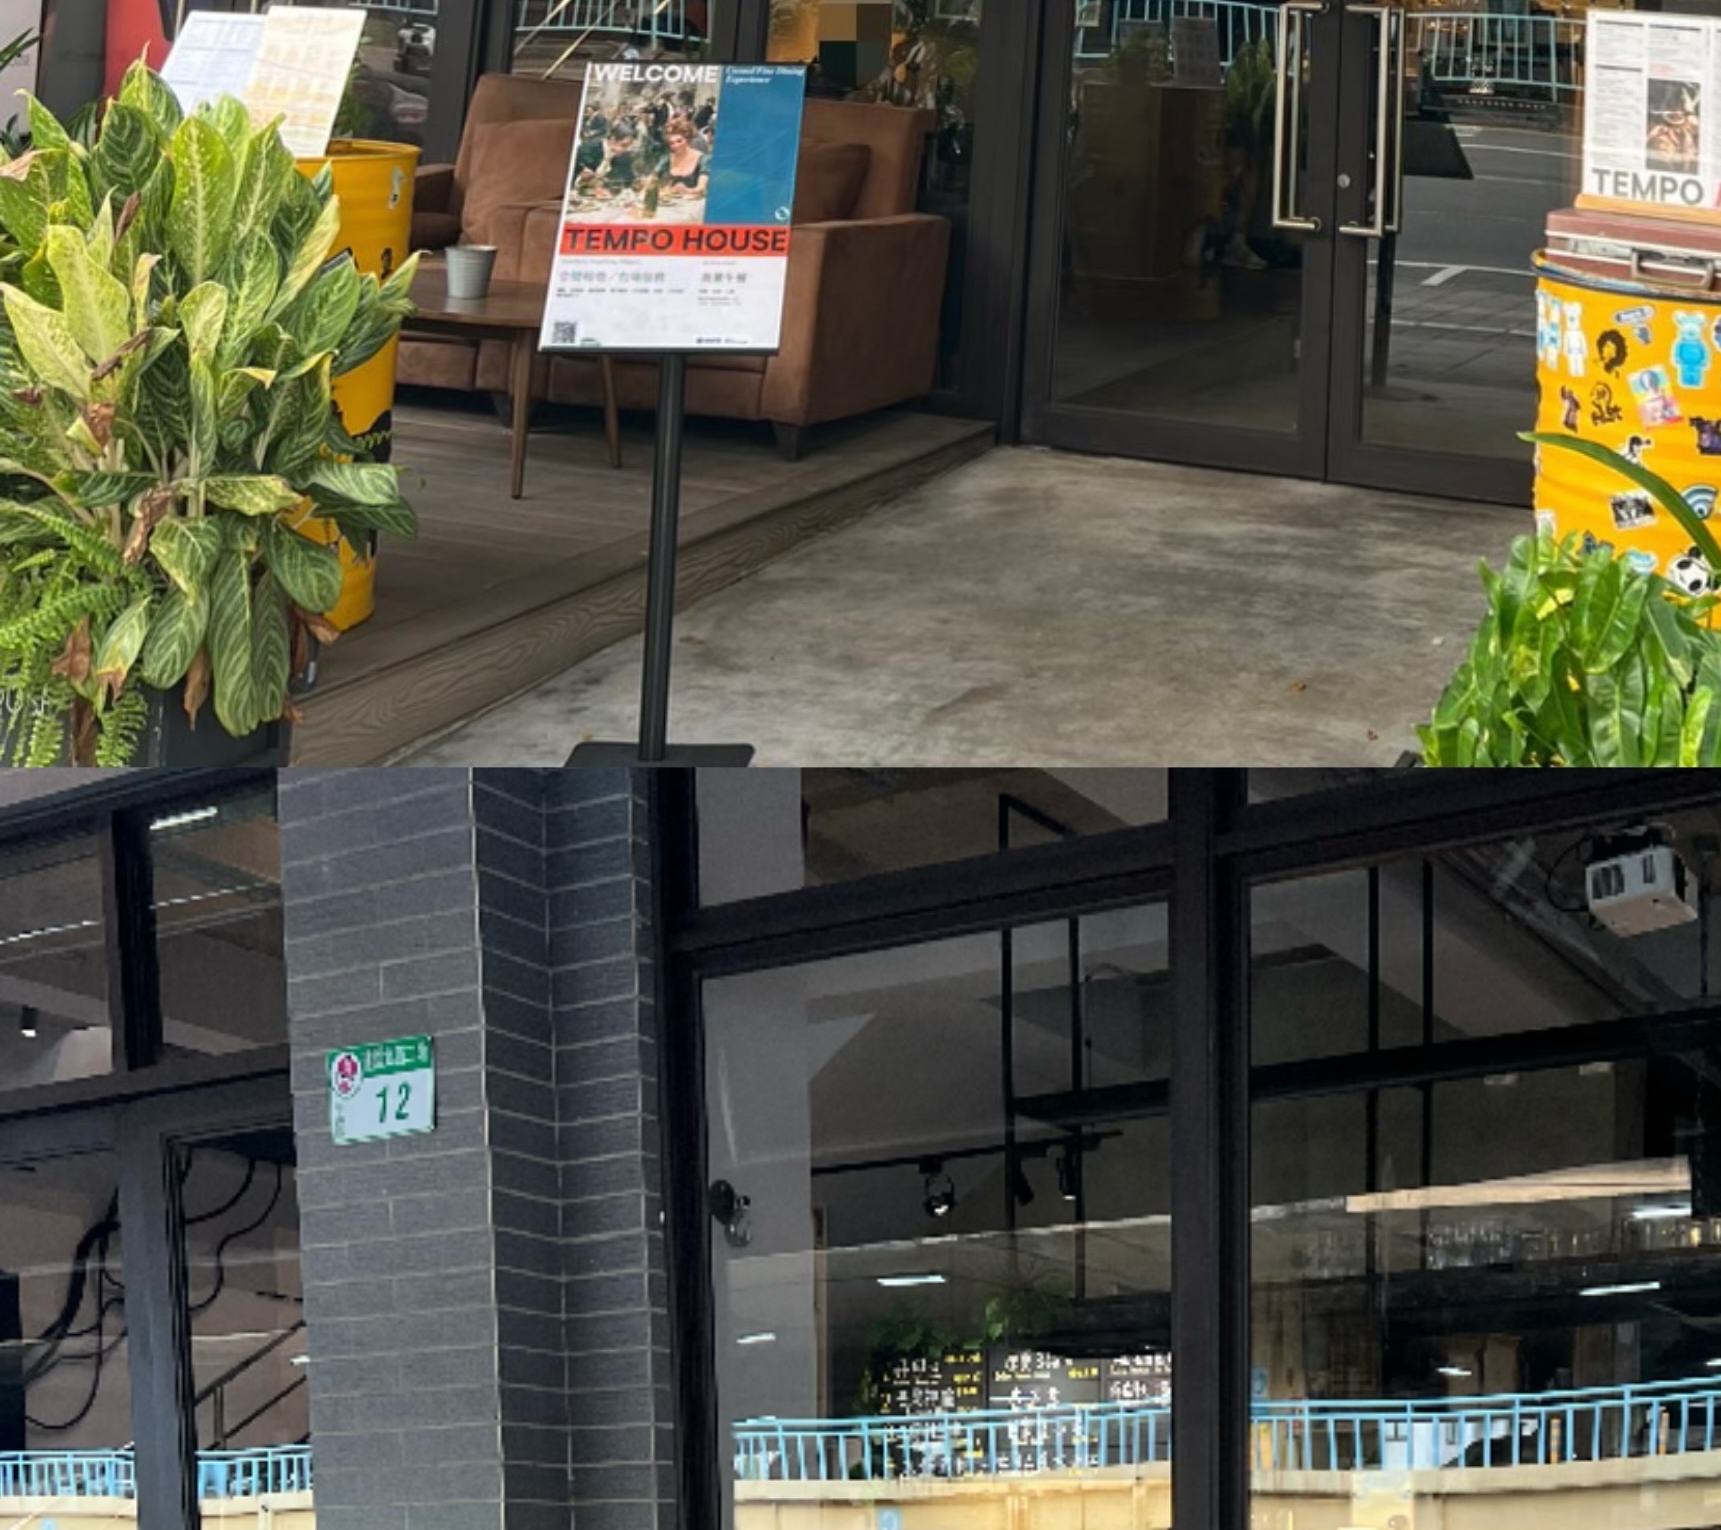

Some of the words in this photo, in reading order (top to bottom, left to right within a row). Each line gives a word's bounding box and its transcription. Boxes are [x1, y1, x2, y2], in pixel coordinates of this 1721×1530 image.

[594, 64, 718, 84] WELCOME
[1591, 168, 1704, 206] TEMPO
[566, 228, 673, 251] TEMPO
[682, 229, 787, 252] HOUSE
[376, 1081, 411, 1124] 12
